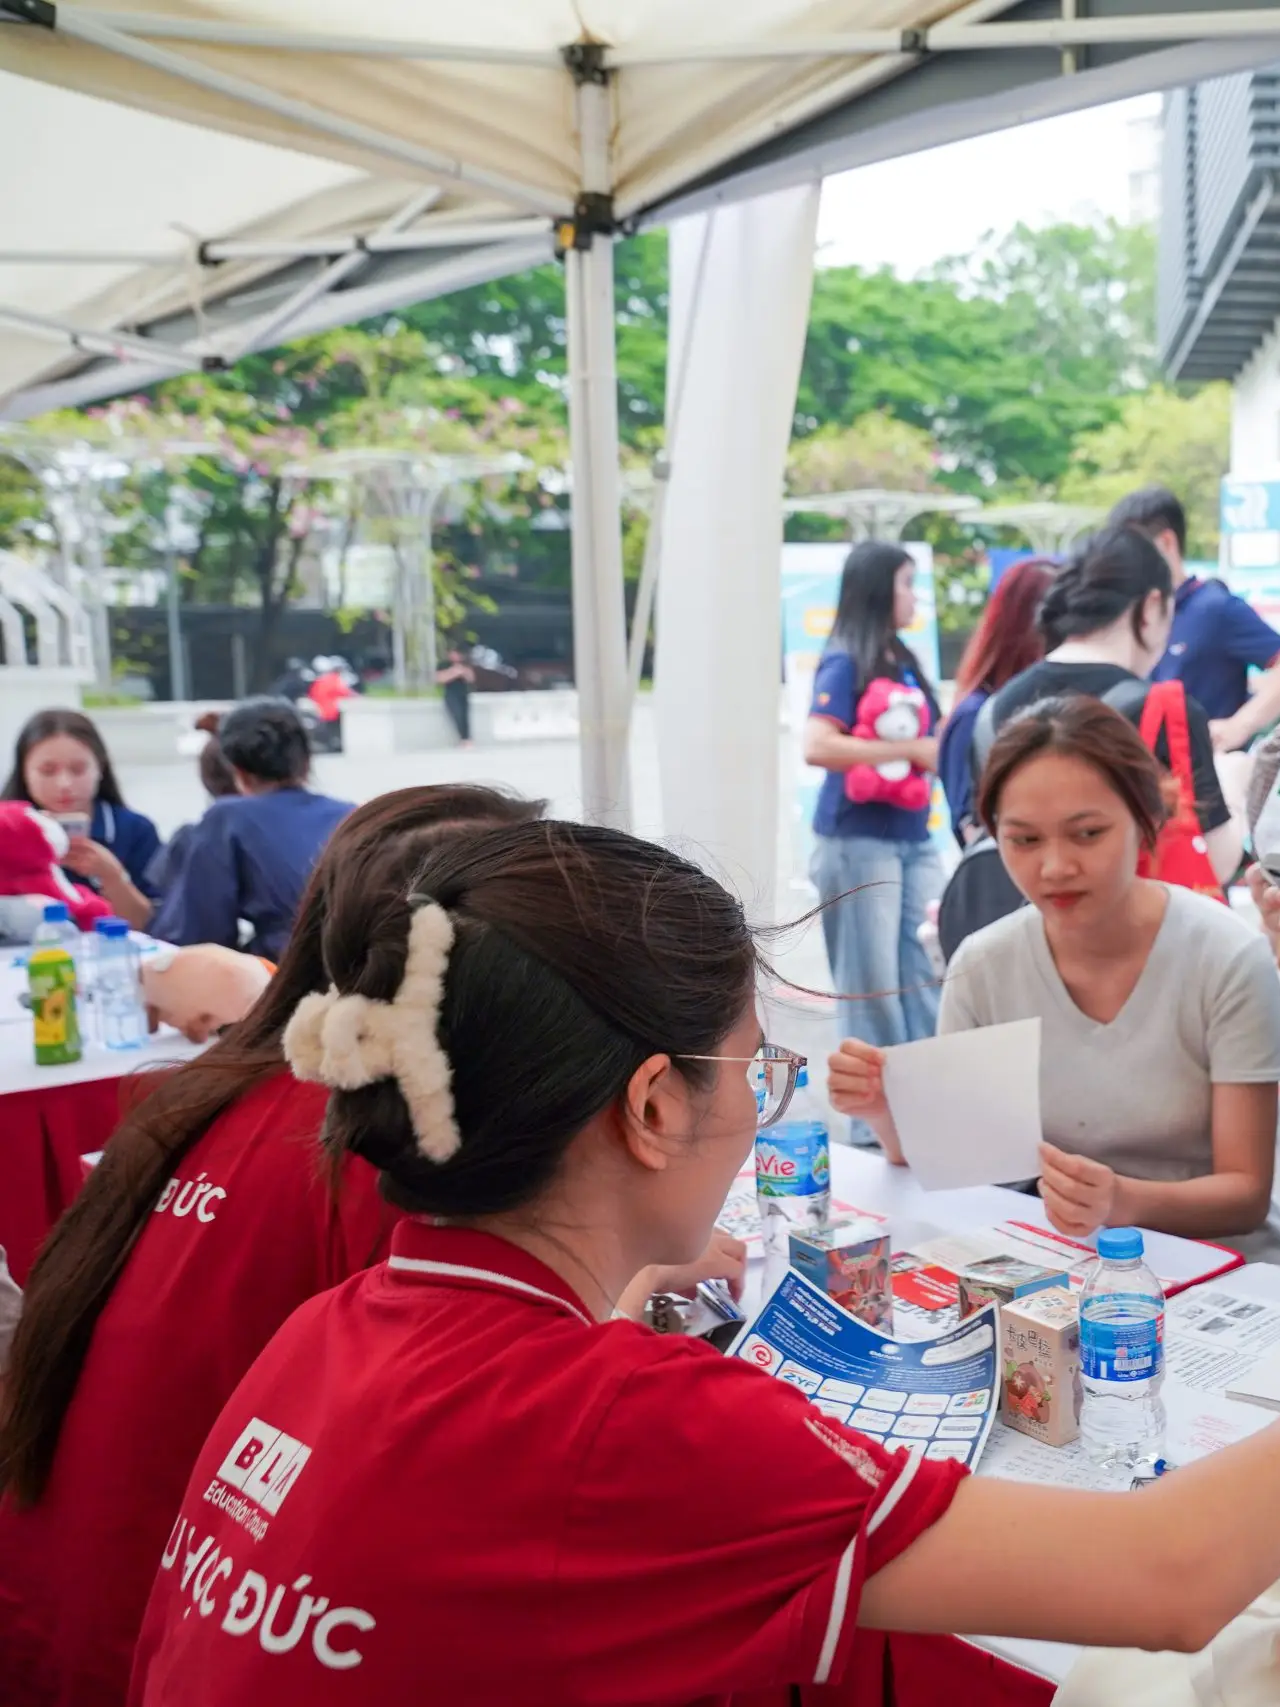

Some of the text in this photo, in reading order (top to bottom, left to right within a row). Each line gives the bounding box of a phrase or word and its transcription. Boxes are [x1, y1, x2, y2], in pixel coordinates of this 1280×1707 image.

[155, 1171, 227, 1223] ĐỨC
[783, 1372, 818, 1388] ZYF
[233, 1436, 299, 1498] BLA
[203, 1479, 253, 1525] Education
[180, 1525, 234, 1620] HỌC
[220, 1568, 377, 1671] ĐỨC
